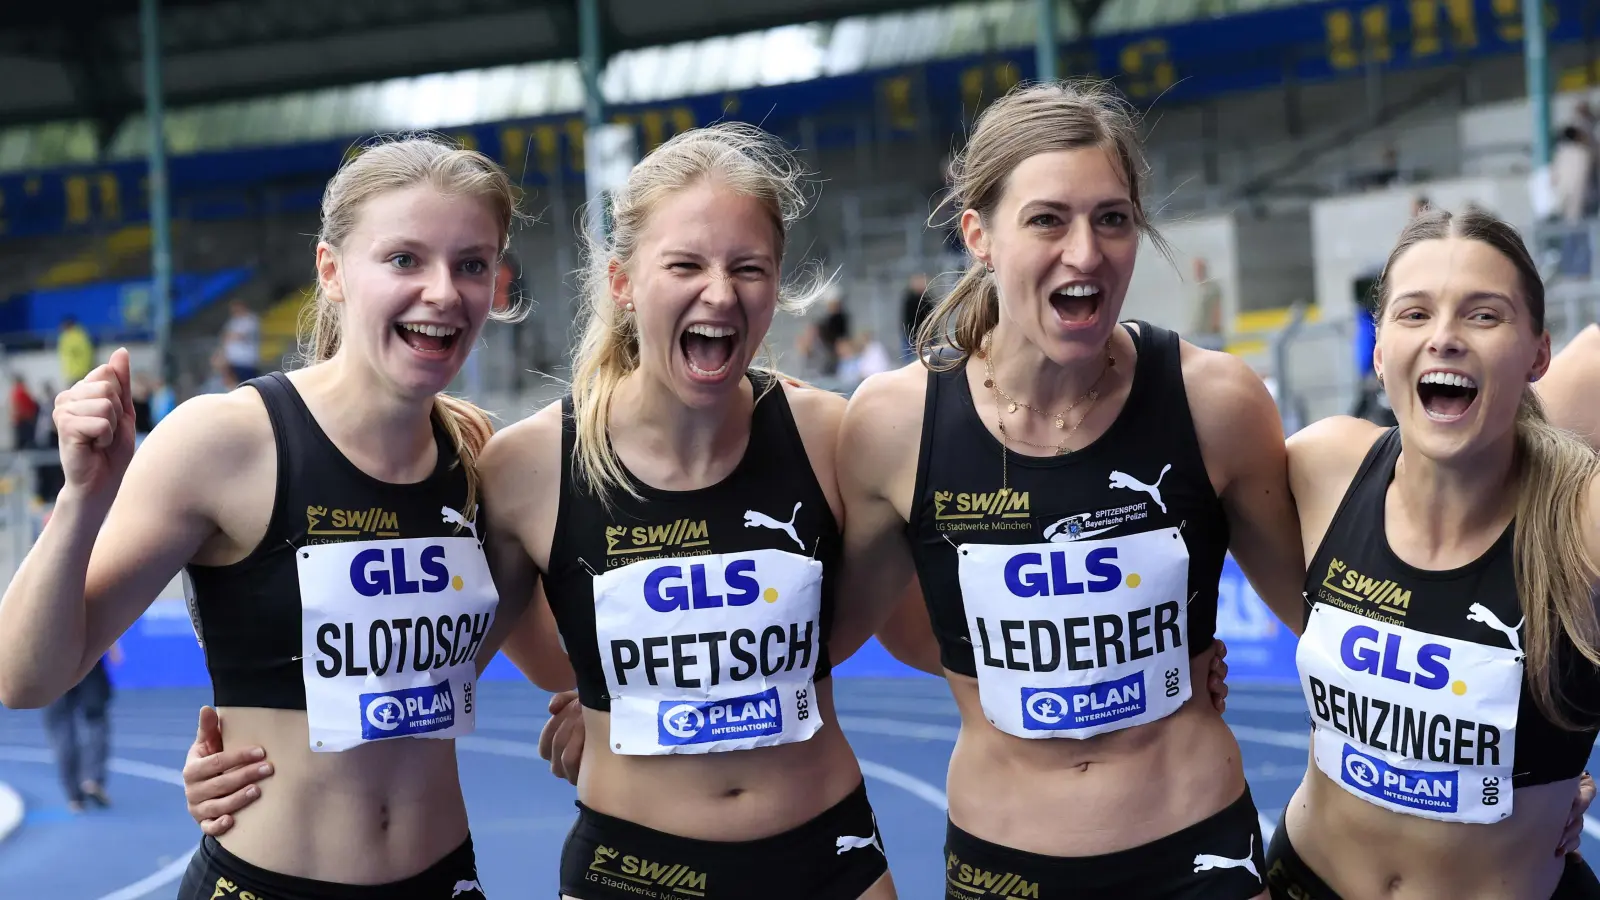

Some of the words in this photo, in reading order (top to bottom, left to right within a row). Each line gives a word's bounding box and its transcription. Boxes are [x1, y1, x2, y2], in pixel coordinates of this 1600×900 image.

[1085, 516, 1124, 529] Bayerische
[1125, 510, 1148, 522] Polizei
[1095, 502, 1148, 518] SPITZENSPORT
[935, 523, 945, 531] LG
[947, 522, 990, 531] Stadtwerke
[991, 520, 1032, 531] München
[606, 557, 618, 568] LG
[1325, 593, 1364, 616] Stadtwerke
[1365, 609, 1405, 628] München
[316, 613, 490, 678] SLOTOSCH
[976, 600, 1182, 672] LEDERER
[610, 620, 814, 688] PFETSCH
[1165, 667, 1180, 698] 330
[406, 690, 452, 718] PLAN
[463, 682, 473, 714] 350
[709, 698, 777, 724] PLAN
[795, 688, 809, 721] 338
[1072, 682, 1141, 713] PLAN
[409, 715, 452, 728] INTERNATIONAL
[1075, 703, 1141, 723] INTERNATIONAL
[1309, 675, 1500, 766] BENZINGER
[711, 721, 777, 735] INTERNATIONAL
[1383, 770, 1452, 798] PLAN
[1482, 776, 1499, 806] 309
[1383, 789, 1452, 808] INTERNATIONAL
[584, 872, 599, 882] LG
[600, 876, 657, 898] Stadtwerke
